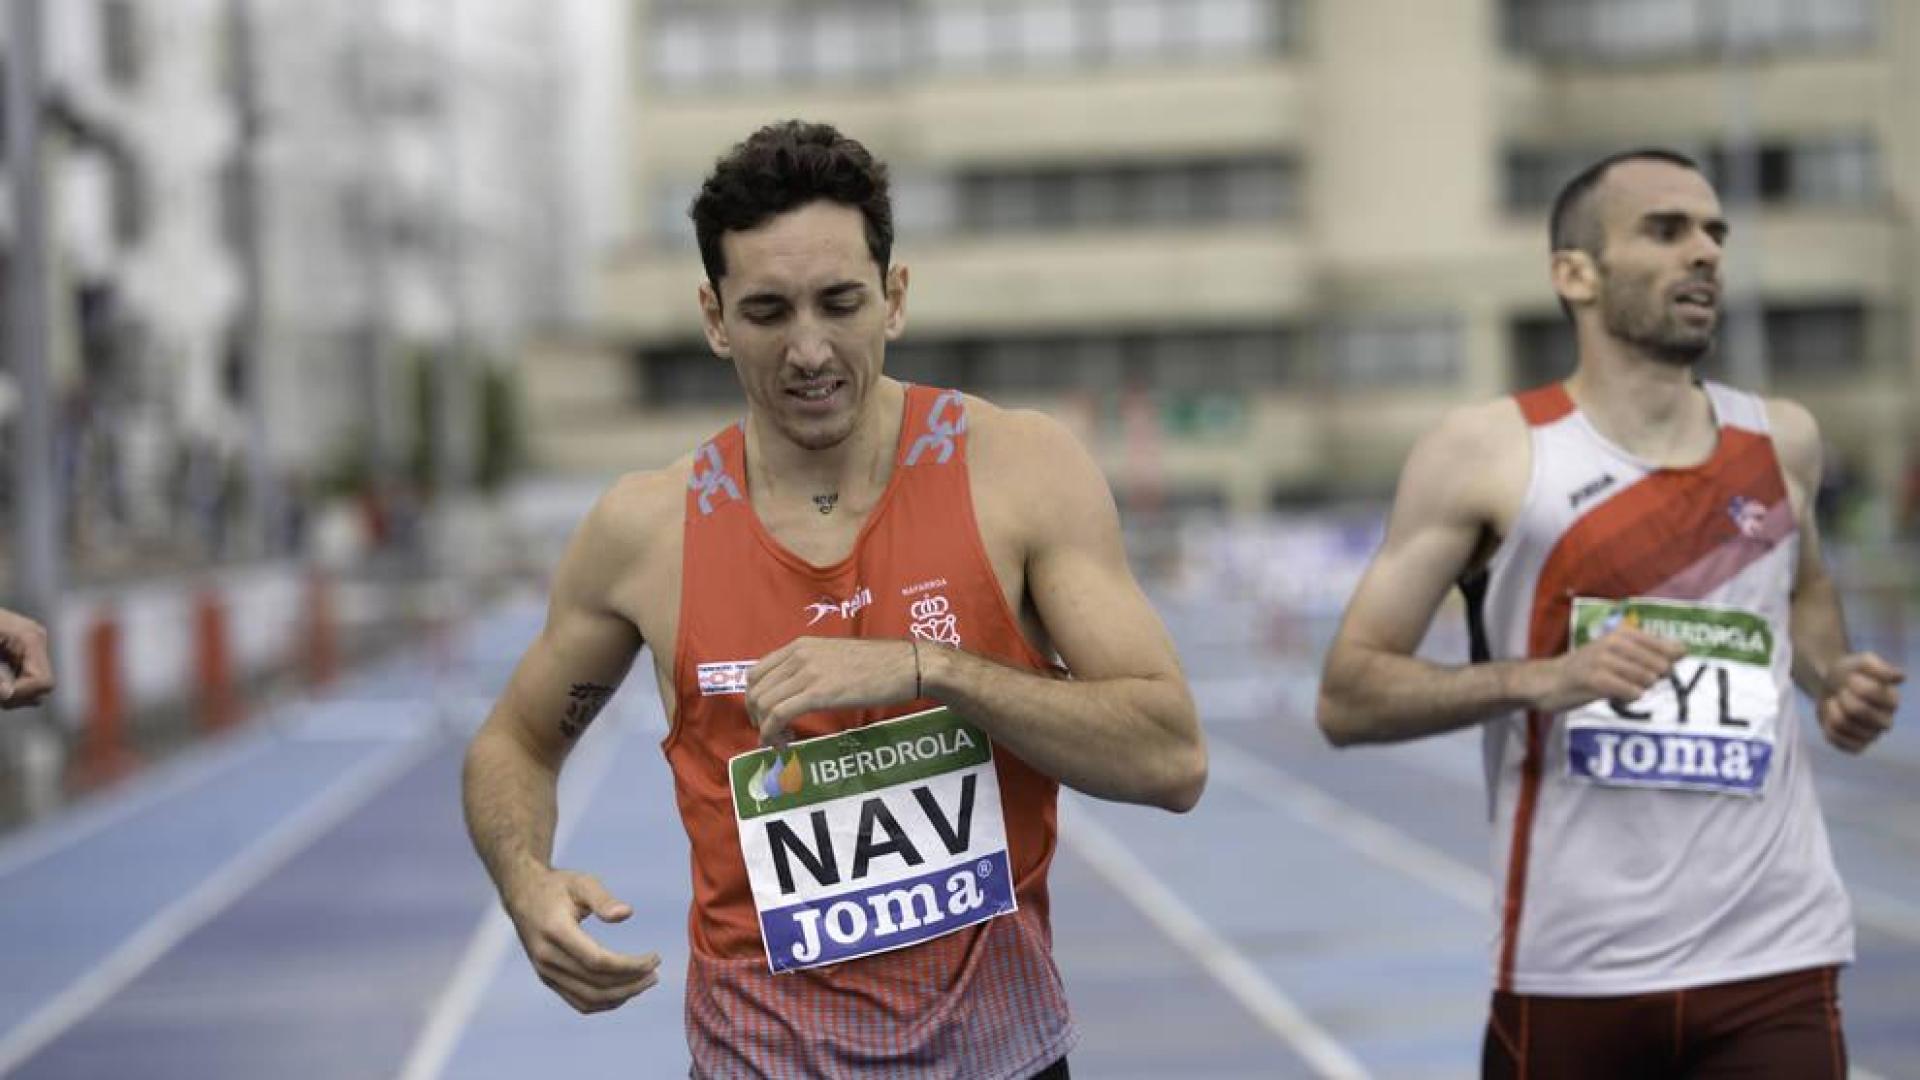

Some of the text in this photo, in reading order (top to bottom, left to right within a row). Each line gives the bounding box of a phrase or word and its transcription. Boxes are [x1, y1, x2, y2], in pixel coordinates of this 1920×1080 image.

[810, 728, 976, 786] IBERDROLA
[1586, 733, 1754, 781] Joma
[765, 773, 978, 896] NAV
[791, 870, 984, 962] Joma
